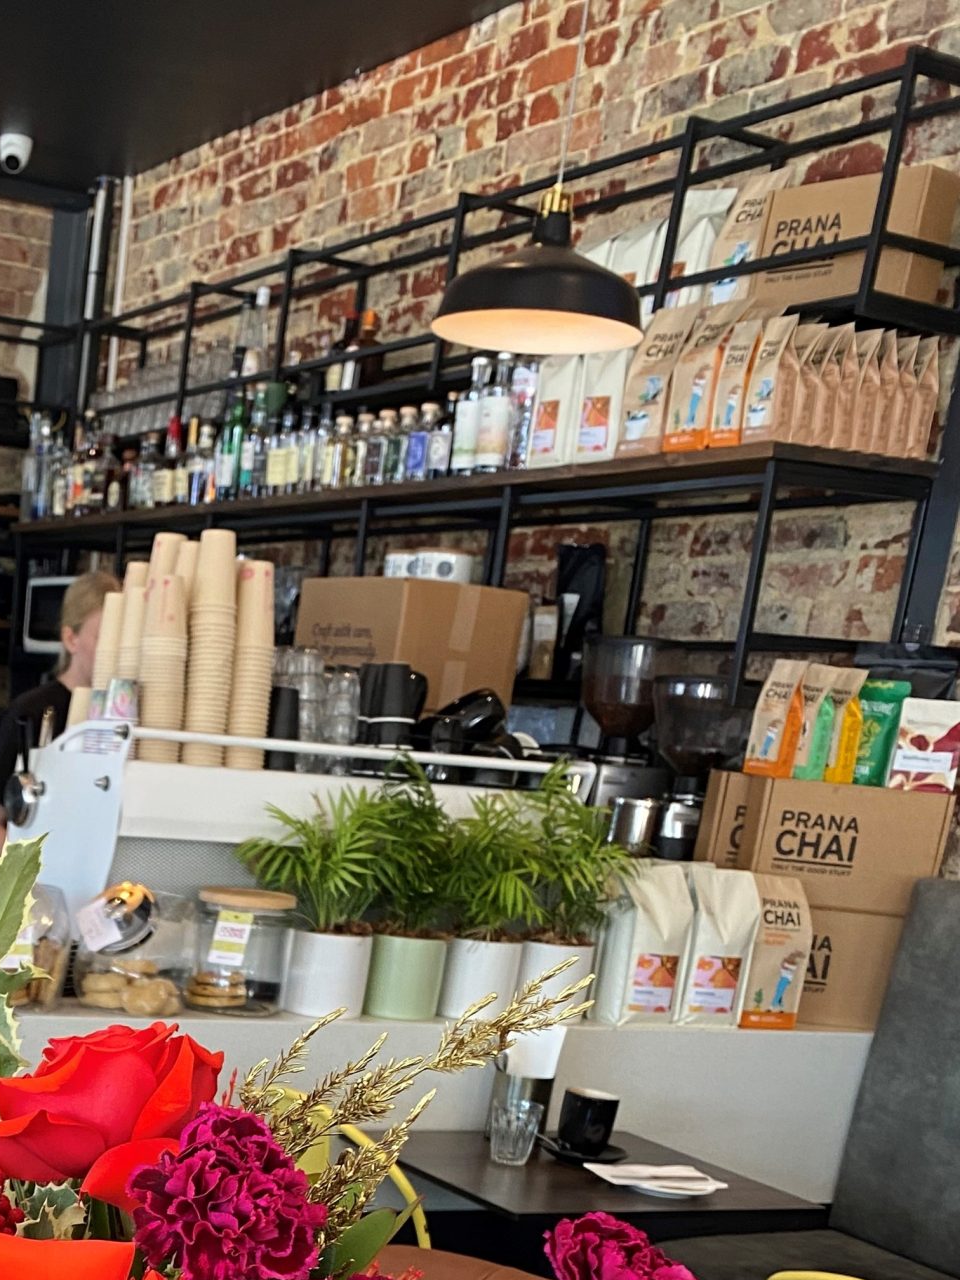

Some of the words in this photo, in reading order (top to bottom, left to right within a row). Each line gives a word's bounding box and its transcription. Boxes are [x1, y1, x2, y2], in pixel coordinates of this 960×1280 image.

[775, 212, 842, 239] PRANA
[780, 809, 859, 834] PRANA
[775, 830, 858, 863] CHAI
[762, 897, 800, 910] PRANA
[763, 910, 801, 927] CHAI
